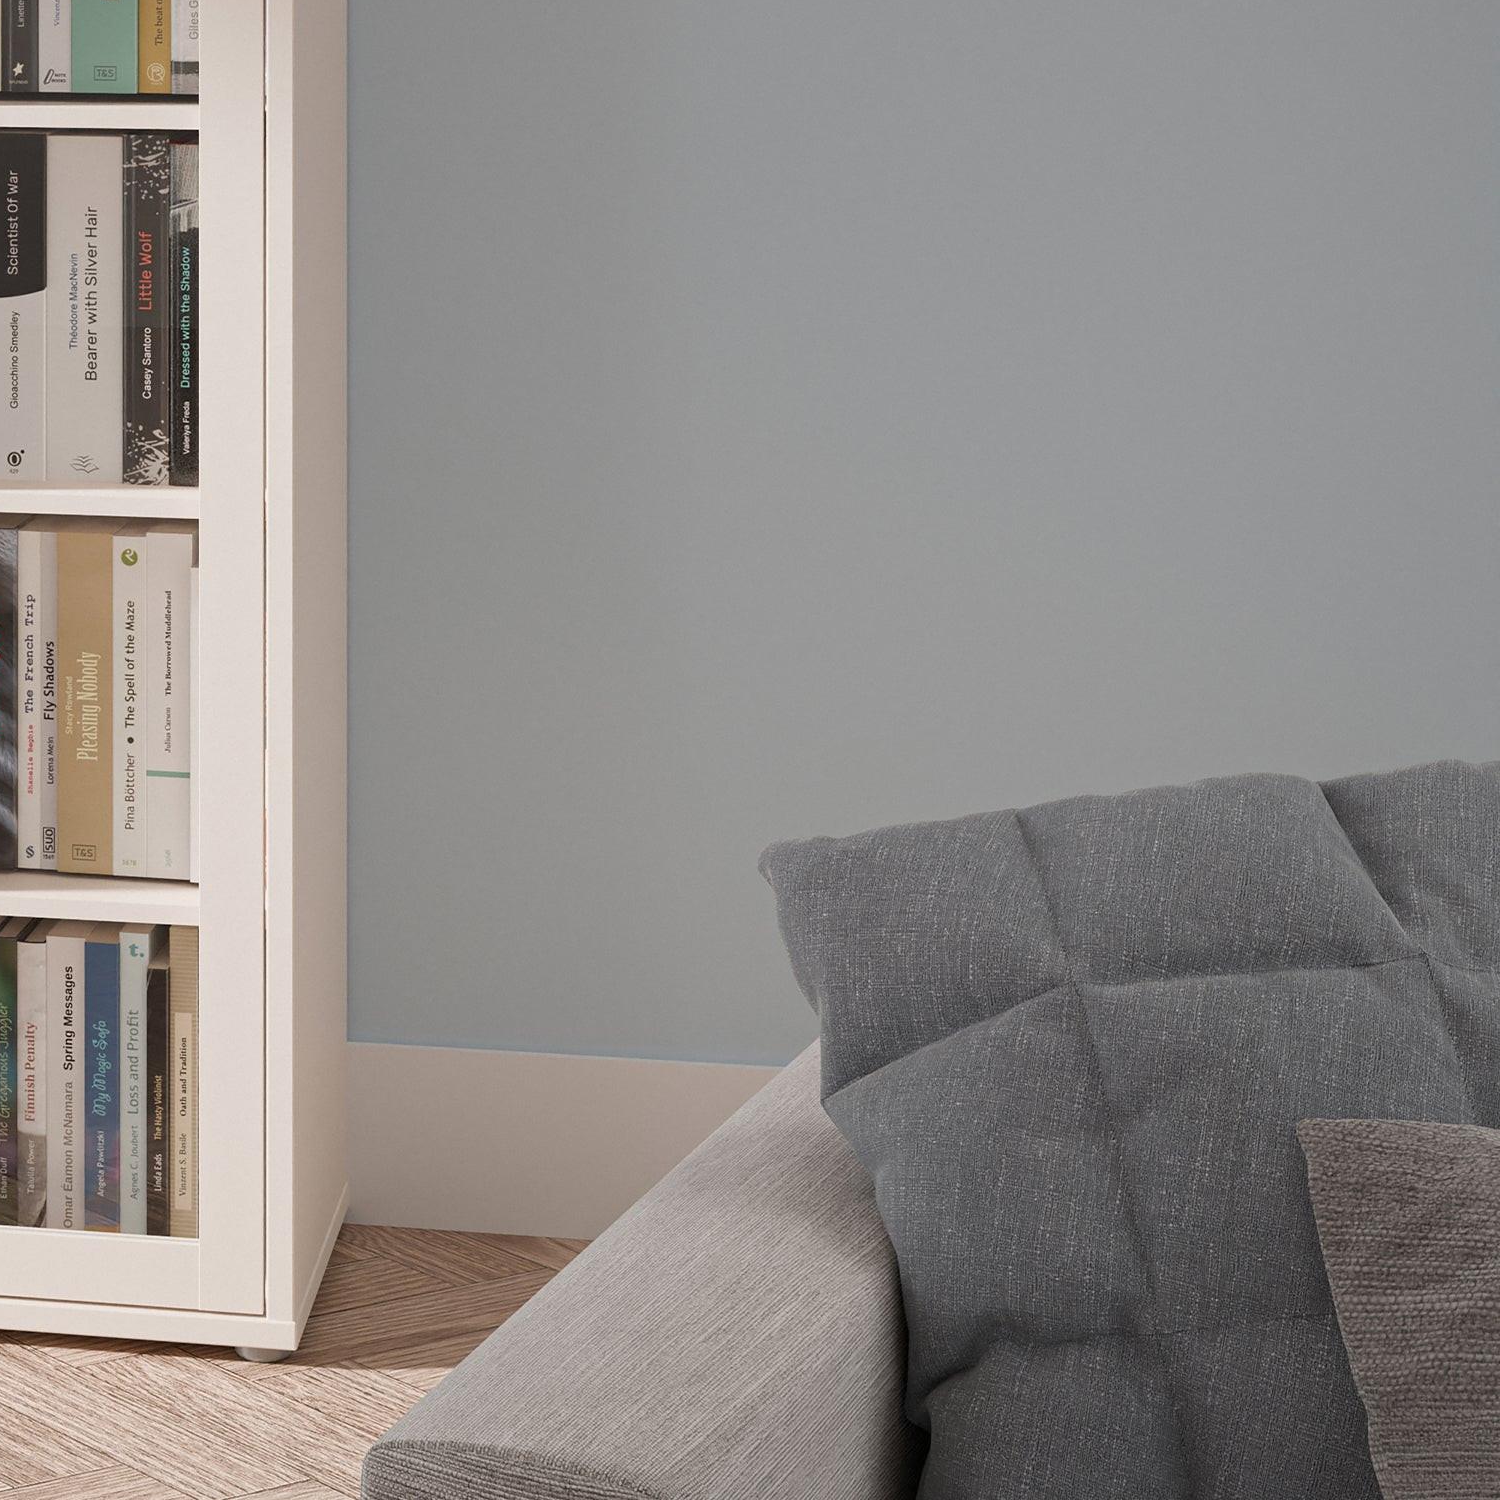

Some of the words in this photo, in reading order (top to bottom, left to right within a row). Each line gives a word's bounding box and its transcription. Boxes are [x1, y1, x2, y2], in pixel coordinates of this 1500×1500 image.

[154, 7, 163, 28] beat
[155, 30, 163, 45] The
[8, 170, 18, 196] War
[7, 198, 18, 213] Of
[85, 206, 97, 237] Hair
[7, 216, 18, 275] Scientist
[138, 232, 152, 265] Wolf
[85, 242, 97, 286] Silver
[180, 246, 190, 292] Shadow
[139, 270, 152, 310] Little
[181, 294, 190, 313] the
[85, 291, 97, 324] with
[181, 316, 190, 340] with
[85, 330, 97, 380] Bearer
[180, 342, 190, 388] Dressed
[25, 594, 36, 626] Trip
[126, 601, 134, 631] Maze
[25, 635, 33, 681] French
[125, 635, 134, 654] the
[44, 642, 54, 696] Shadows
[76, 651, 101, 701] Nobody
[125, 658, 134, 670] of
[24, 690, 33, 713] The
[125, 674, 136, 702] Spell
[44, 701, 56, 720] Fly
[125, 706, 134, 728] The
[76, 705, 101, 760] Pleasing
[125, 753, 134, 802] Böttcher
[125, 806, 134, 830] Pina
[45, 829, 55, 851] SUO
[64, 966, 75, 1026] Messages
[25, 1022, 37, 1070] Penalty
[92, 1020, 110, 1050] Sofa
[127, 1010, 138, 1051] Profit
[63, 1031, 75, 1070] Spring
[92, 1053, 110, 1090] Magic
[127, 1055, 139, 1080] and
[25, 1075, 35, 1121] Finnish
[63, 1082, 73, 1146] McNamara
[92, 1093, 110, 1116] My
[127, 1085, 138, 1114] Loss
[63, 1196, 73, 1228] Omar
